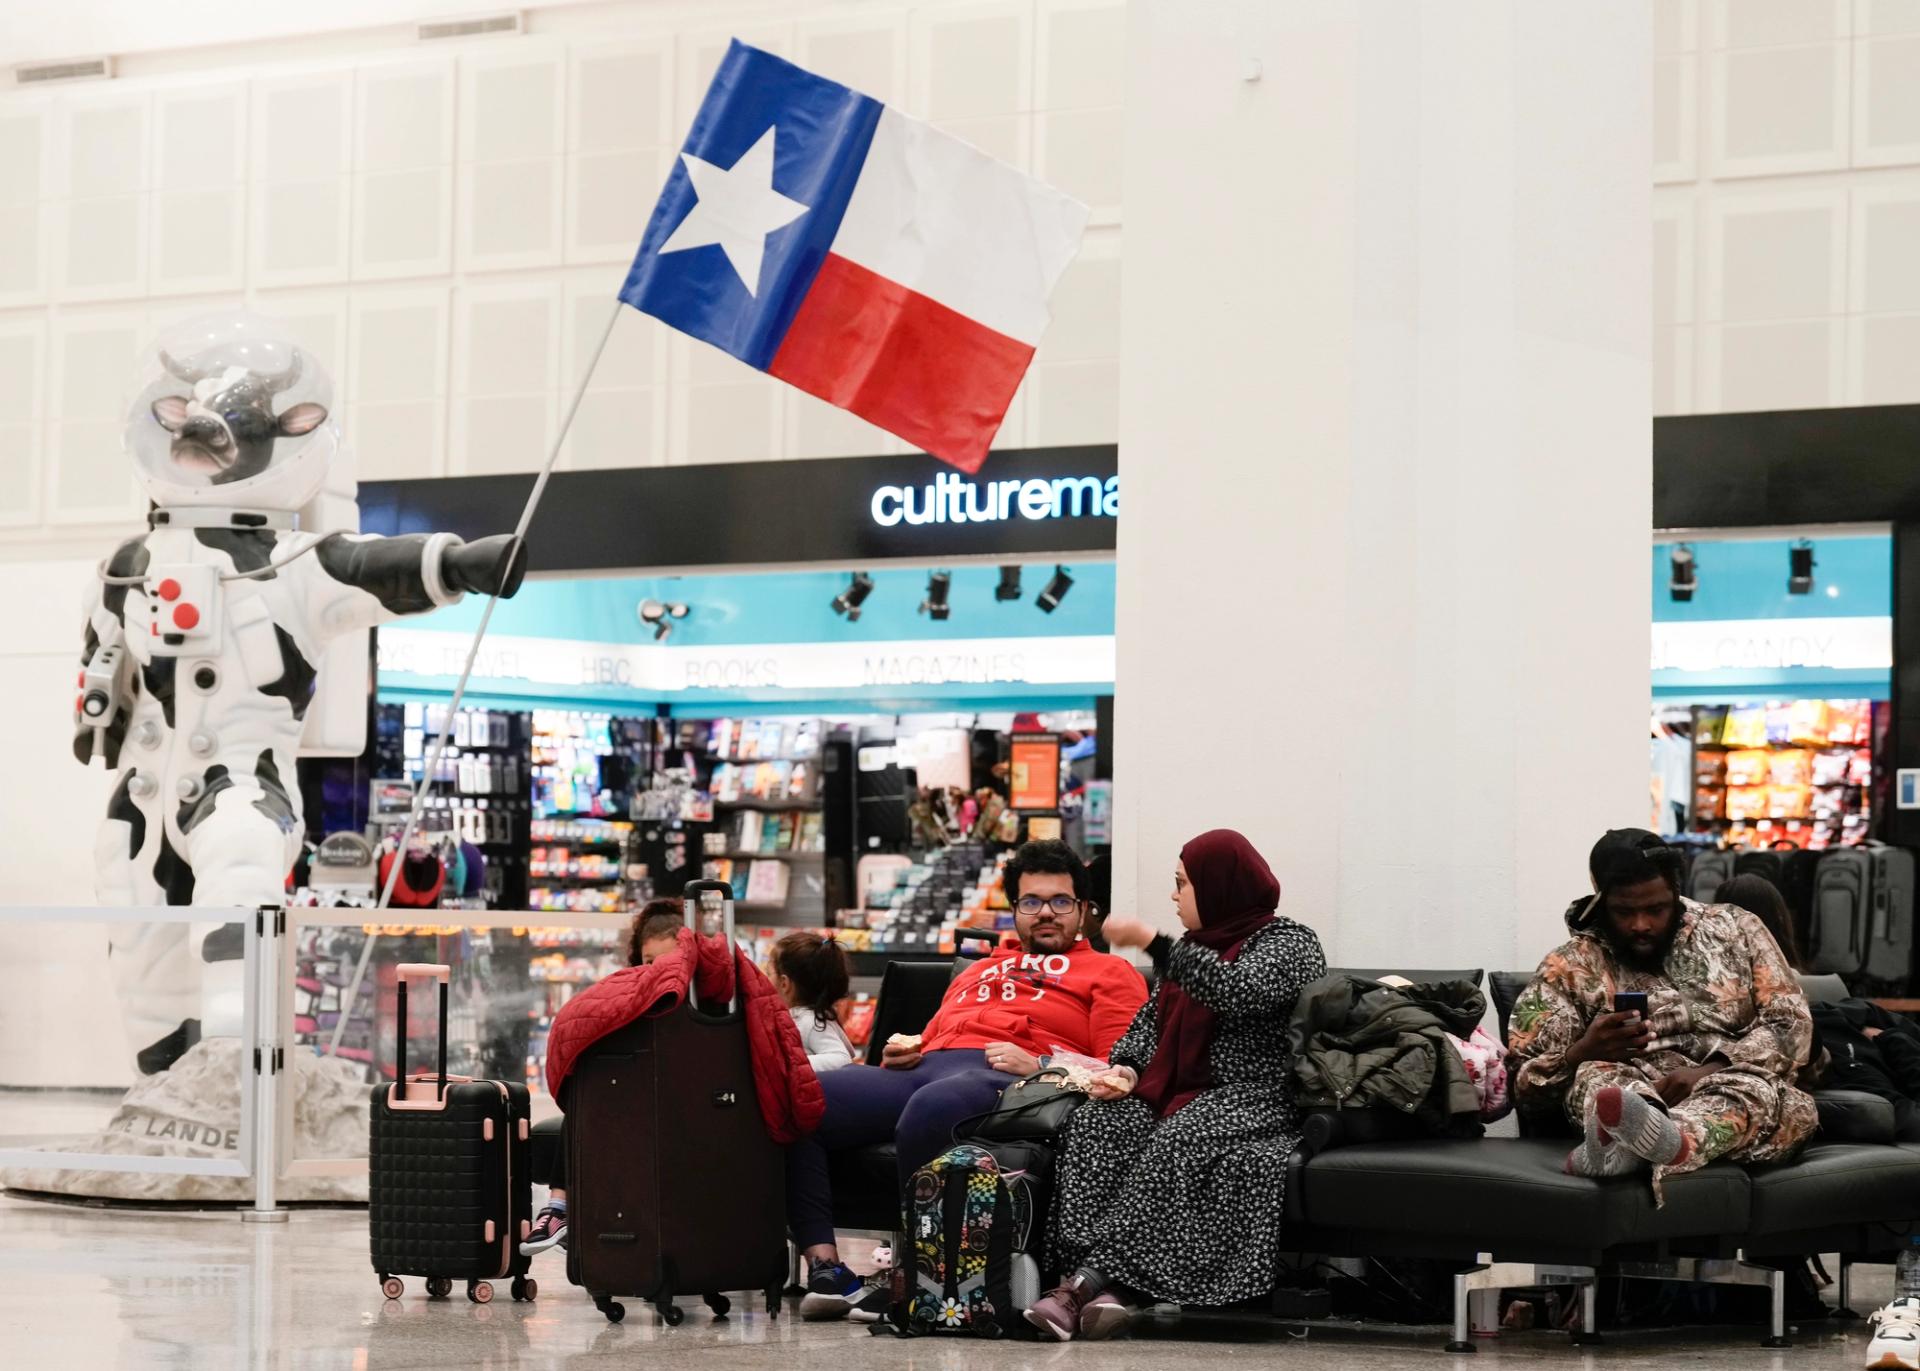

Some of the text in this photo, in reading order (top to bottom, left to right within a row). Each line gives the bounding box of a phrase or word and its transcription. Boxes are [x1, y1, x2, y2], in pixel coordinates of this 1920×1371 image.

[380, 642, 416, 673] YS
[439, 645, 528, 680] TRAVEL
[1714, 635, 1833, 670] CANDY
[580, 656, 633, 687] HBC
[685, 657, 779, 688] BOOKS
[864, 653, 1026, 686] MAGAZINES
